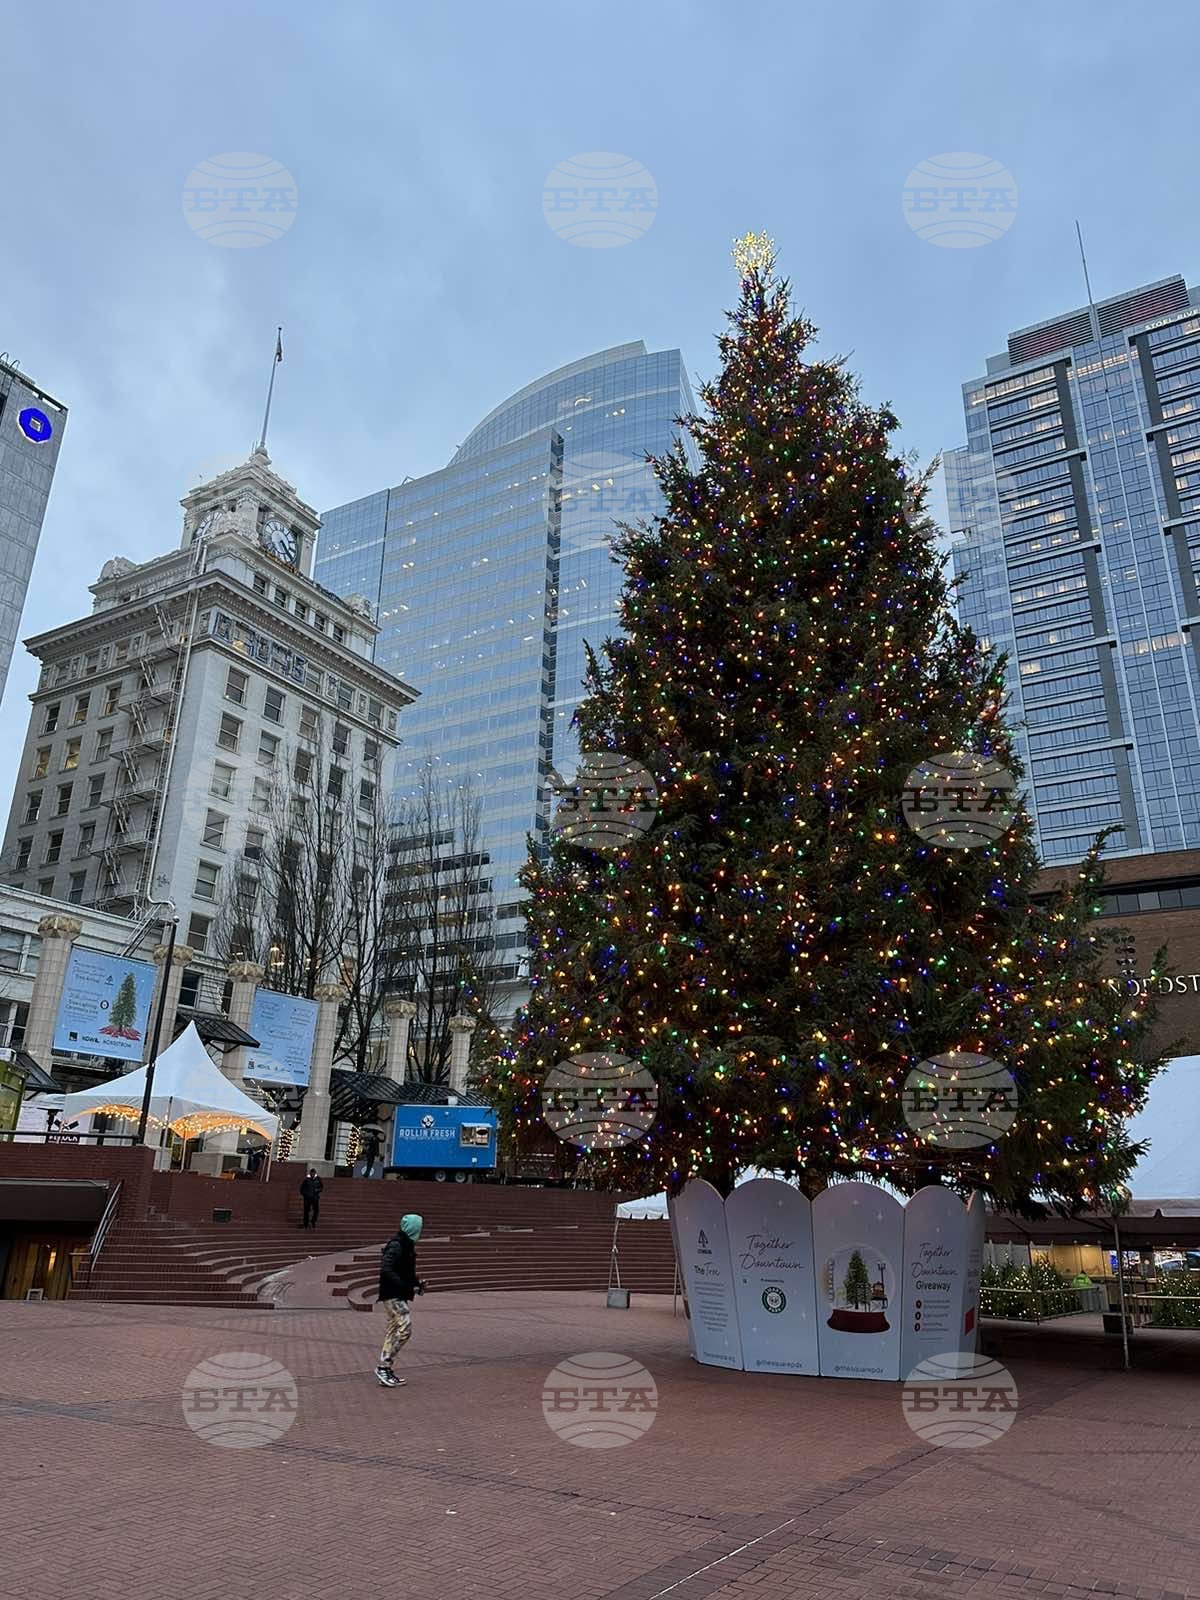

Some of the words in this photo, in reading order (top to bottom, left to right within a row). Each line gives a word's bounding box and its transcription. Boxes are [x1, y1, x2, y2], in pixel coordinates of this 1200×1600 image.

[430, 1129, 456, 1137] FRESH
[746, 1234, 794, 1255] Together
[919, 1242, 953, 1262] Together
[739, 1253, 804, 1270] Downtown
[911, 1262, 958, 1279] Downtown
[915, 1280, 952, 1293] Giveaway
